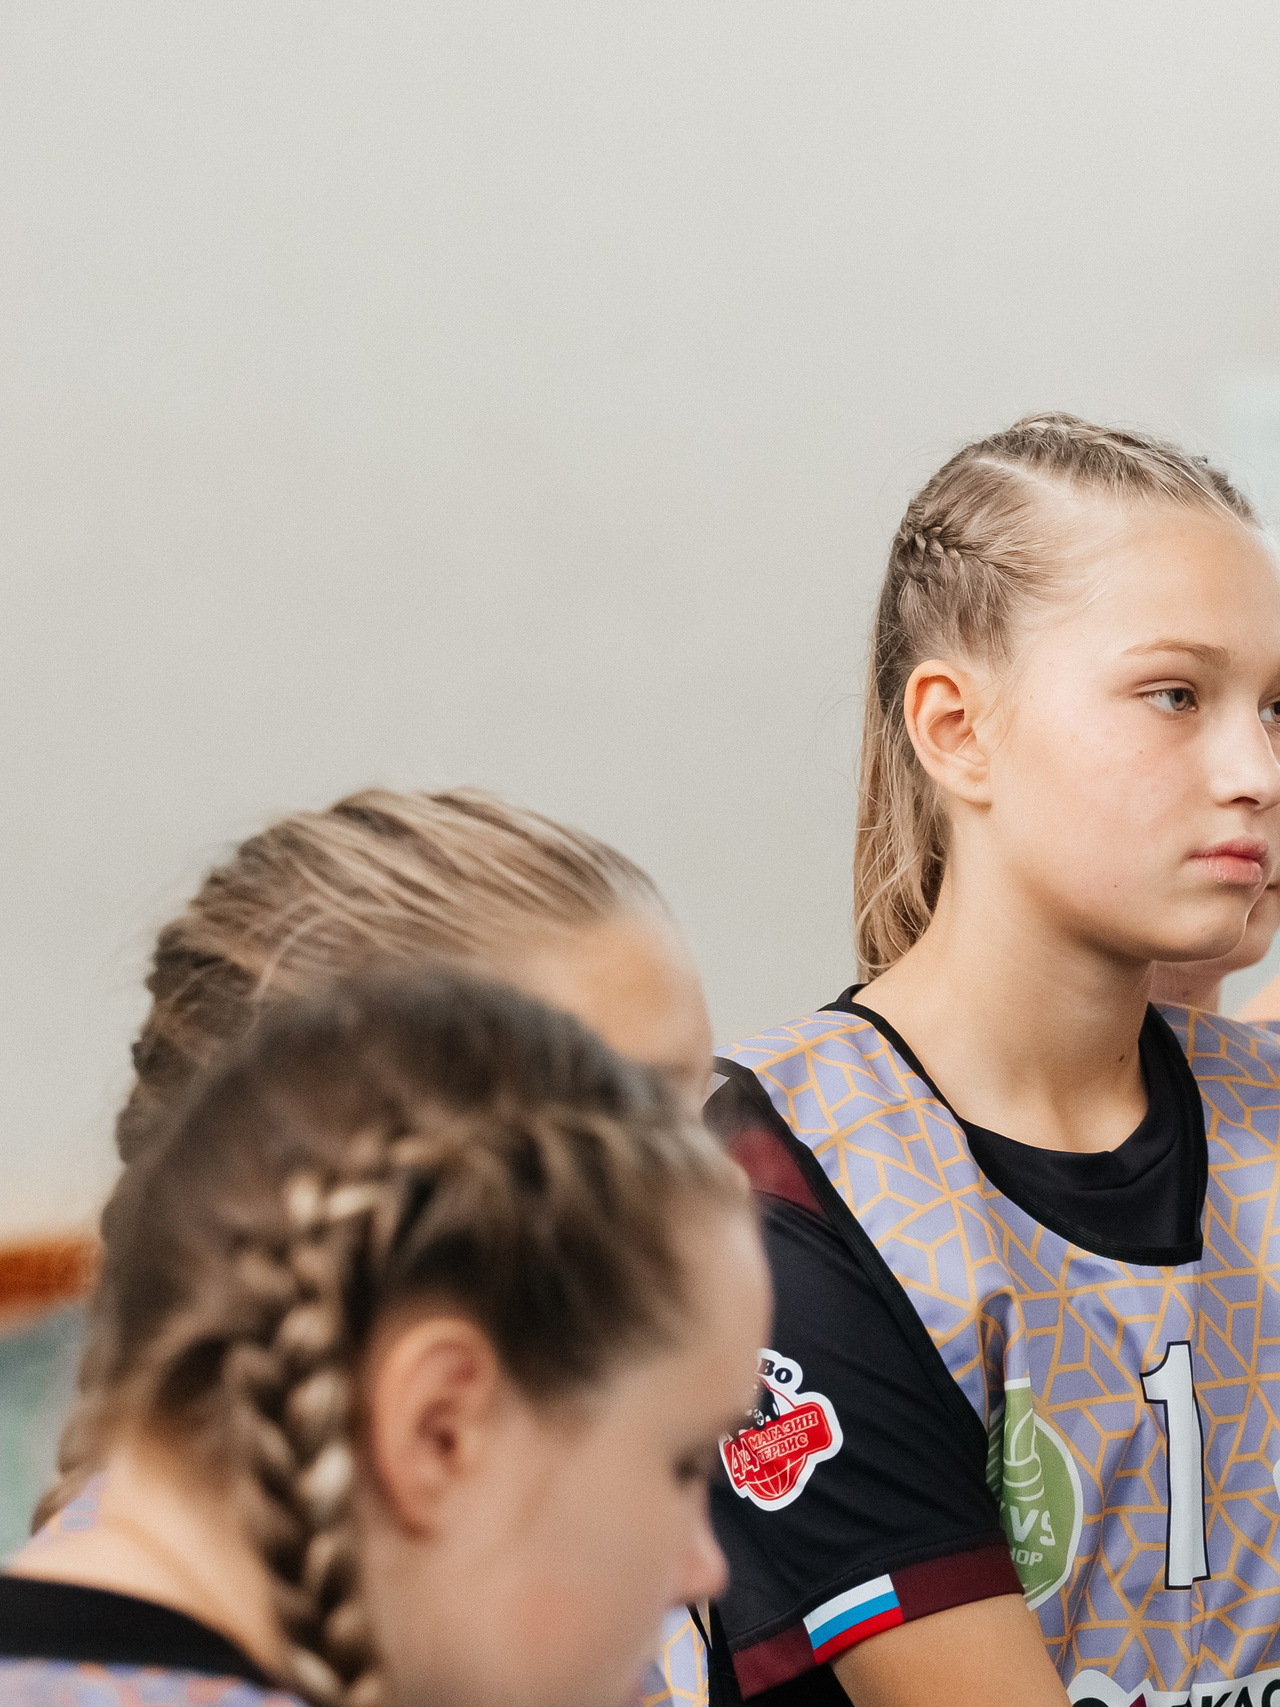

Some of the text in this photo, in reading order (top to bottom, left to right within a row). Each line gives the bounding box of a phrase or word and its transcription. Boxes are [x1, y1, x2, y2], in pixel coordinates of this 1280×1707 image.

[757, 1358, 793, 1384] ВО
[749, 1410, 819, 1450] МАГАЗИН
[1139, 1340, 1211, 1590] 1
[1000, 1502, 1056, 1546] VS
